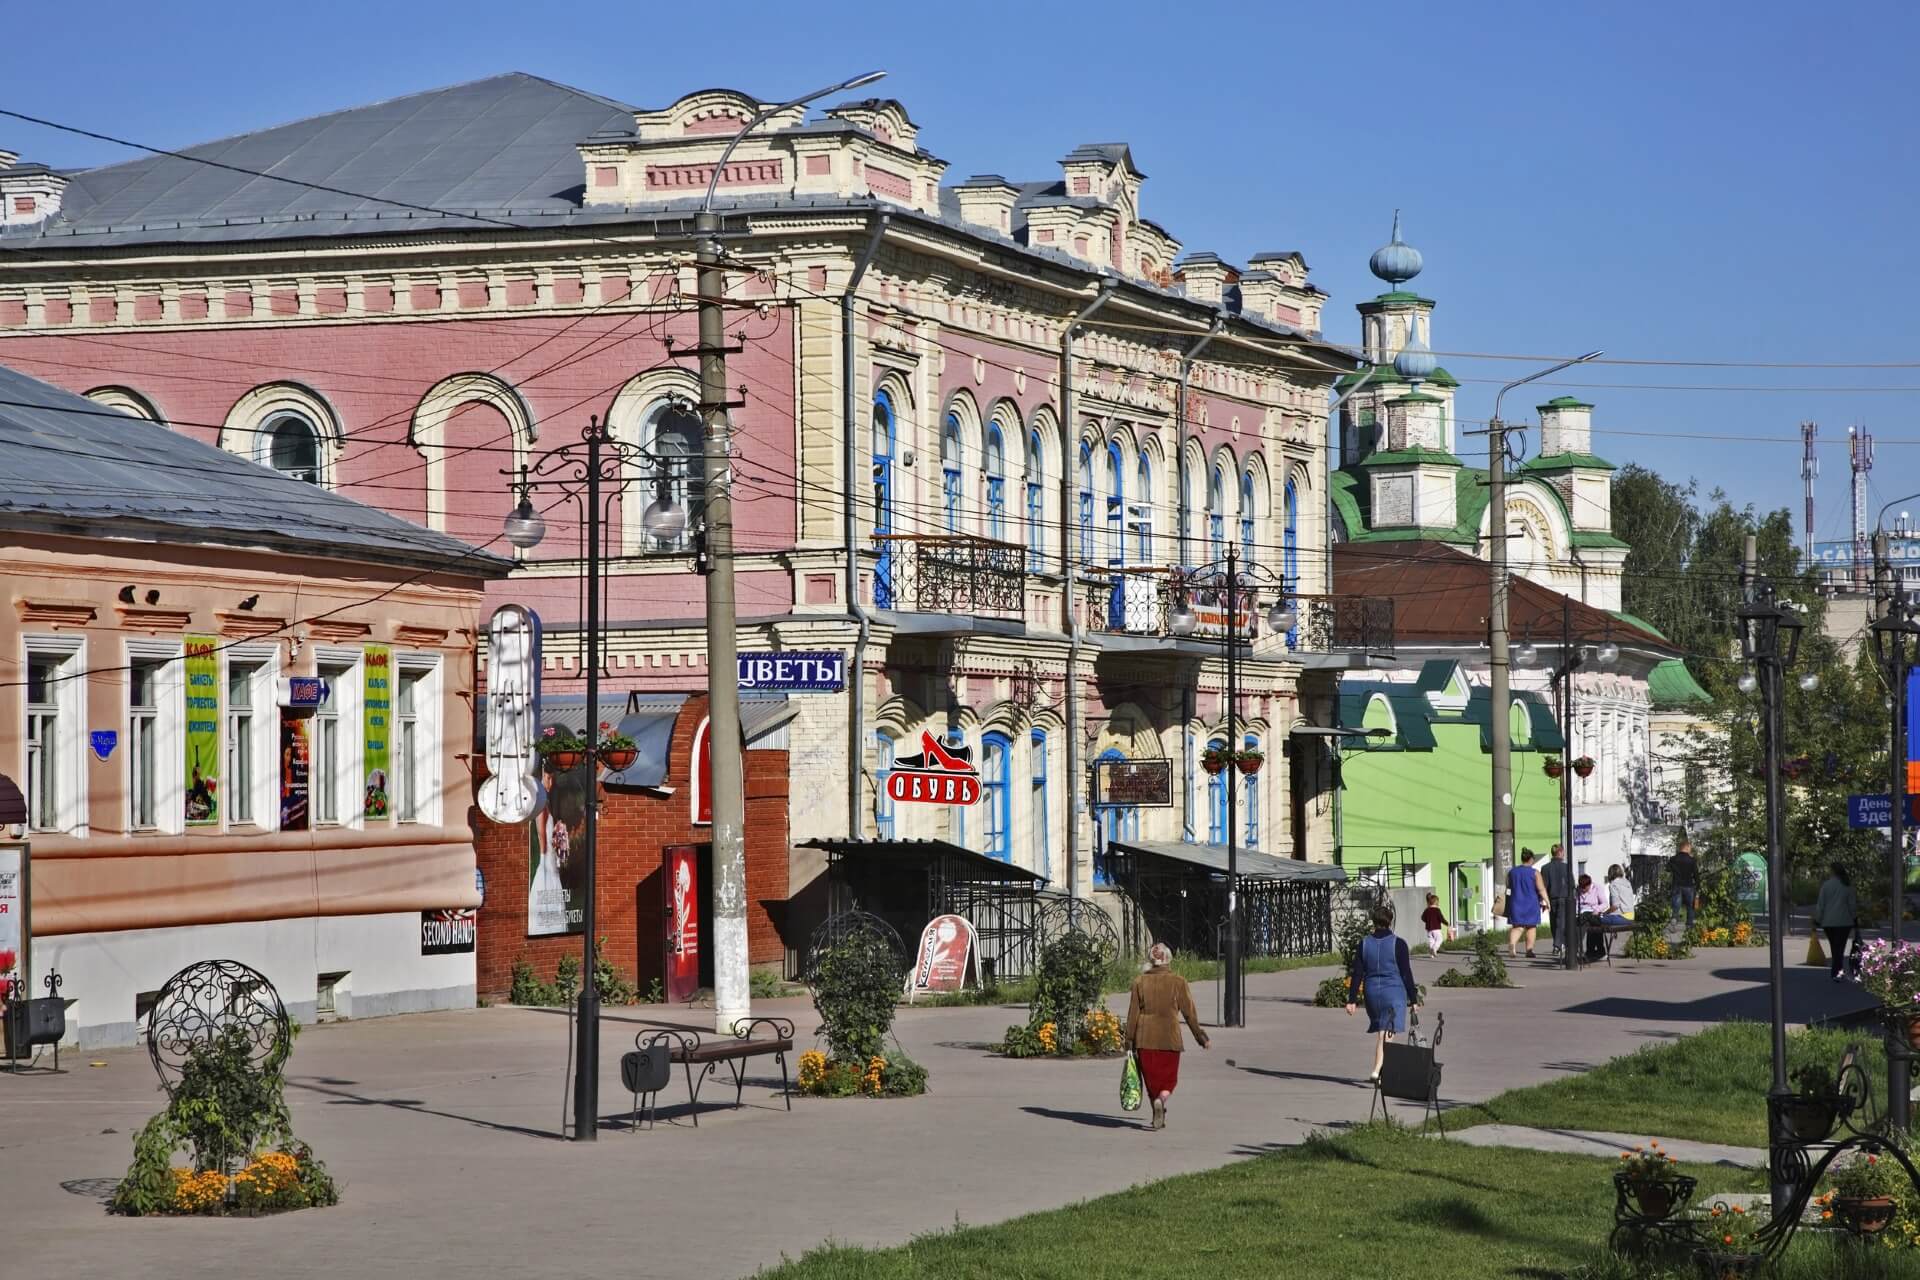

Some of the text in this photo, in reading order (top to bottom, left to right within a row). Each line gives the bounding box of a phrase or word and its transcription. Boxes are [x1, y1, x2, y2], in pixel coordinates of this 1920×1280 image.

[186, 643, 215, 660] КАФЕ
[365, 653, 388, 668] КАФЕ
[736, 659, 842, 687] ЦВЕТЫ
[293, 682, 319, 700] КАФЕ
[895, 776, 971, 802] ОБУВЬ
[423, 919, 473, 946] SECOND HAND
